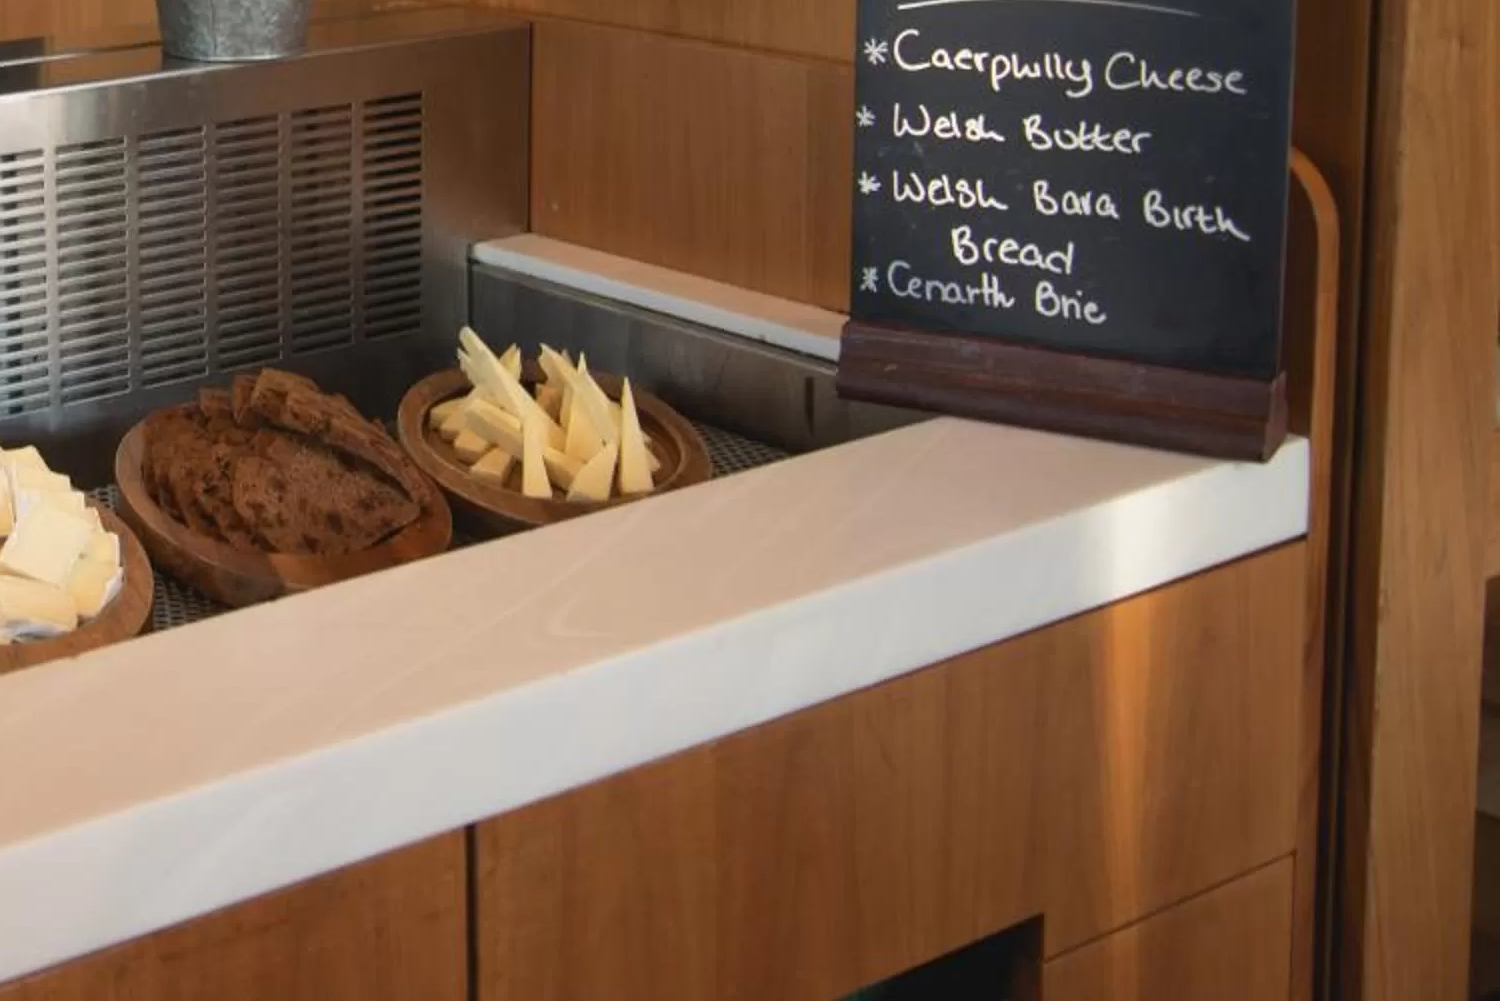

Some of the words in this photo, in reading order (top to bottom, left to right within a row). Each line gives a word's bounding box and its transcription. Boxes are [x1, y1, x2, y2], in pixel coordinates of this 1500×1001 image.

[1104, 51, 1248, 95] Cheese
[893, 102, 1004, 142] Welsh
[1023, 114, 1153, 154] Butter
[893, 170, 1008, 210] Welsh
[1033, 180, 1120, 219] Bara
[1143, 189, 1251, 242] Birth
[951, 224, 1075, 275] Bread
[886, 260, 1015, 309] Cenarth
[1034, 280, 1107, 325] Brie
